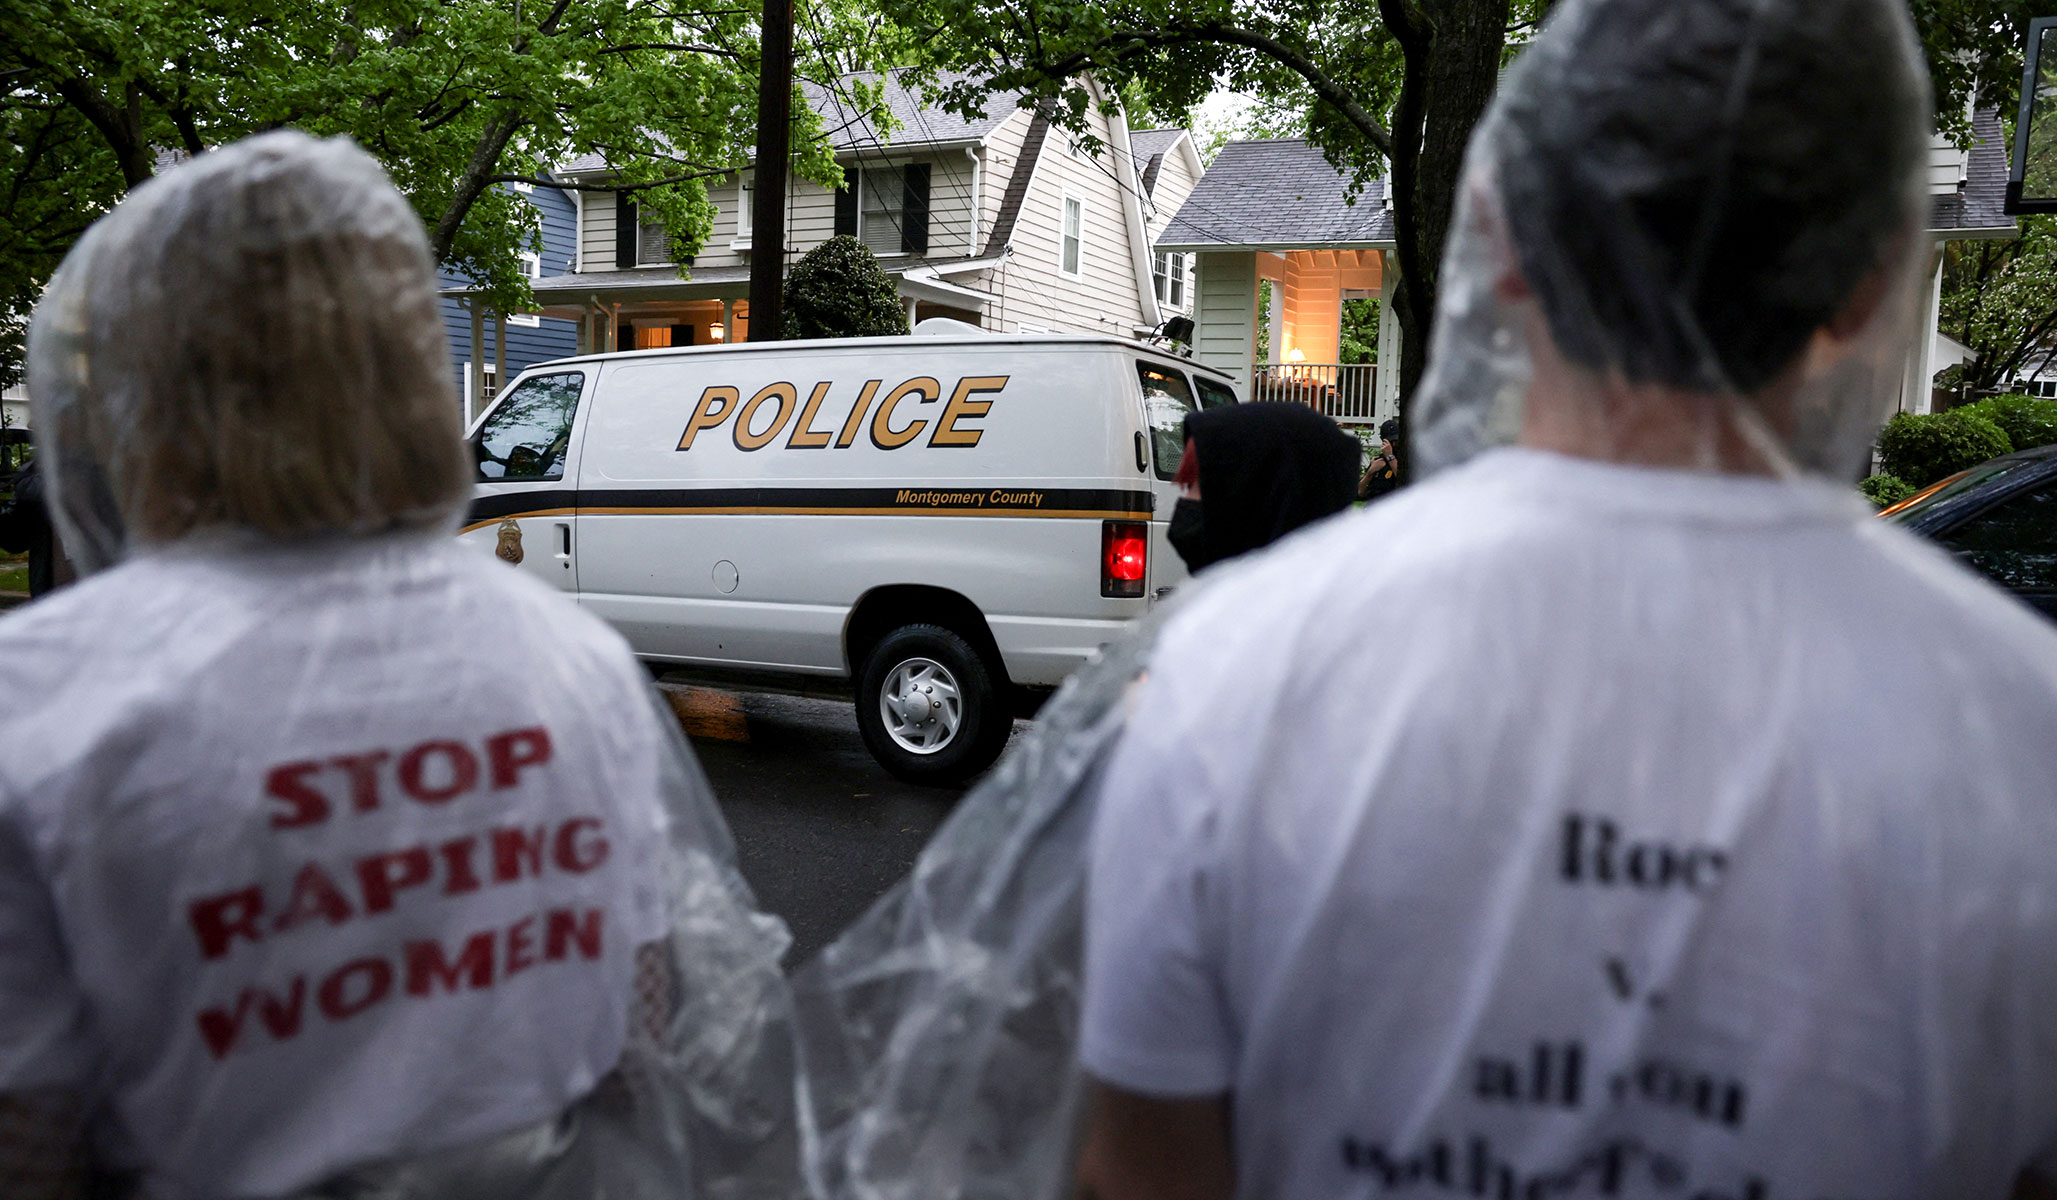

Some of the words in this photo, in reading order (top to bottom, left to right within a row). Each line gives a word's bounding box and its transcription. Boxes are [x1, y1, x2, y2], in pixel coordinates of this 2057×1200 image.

[675, 375, 1011, 452] POLICE
[896, 490, 985, 507] Montgomery
[990, 490, 1043, 507] County
[264, 725, 553, 830] STOP
[189, 816, 610, 962] RAPING
[196, 908, 606, 1062] WOMEN
